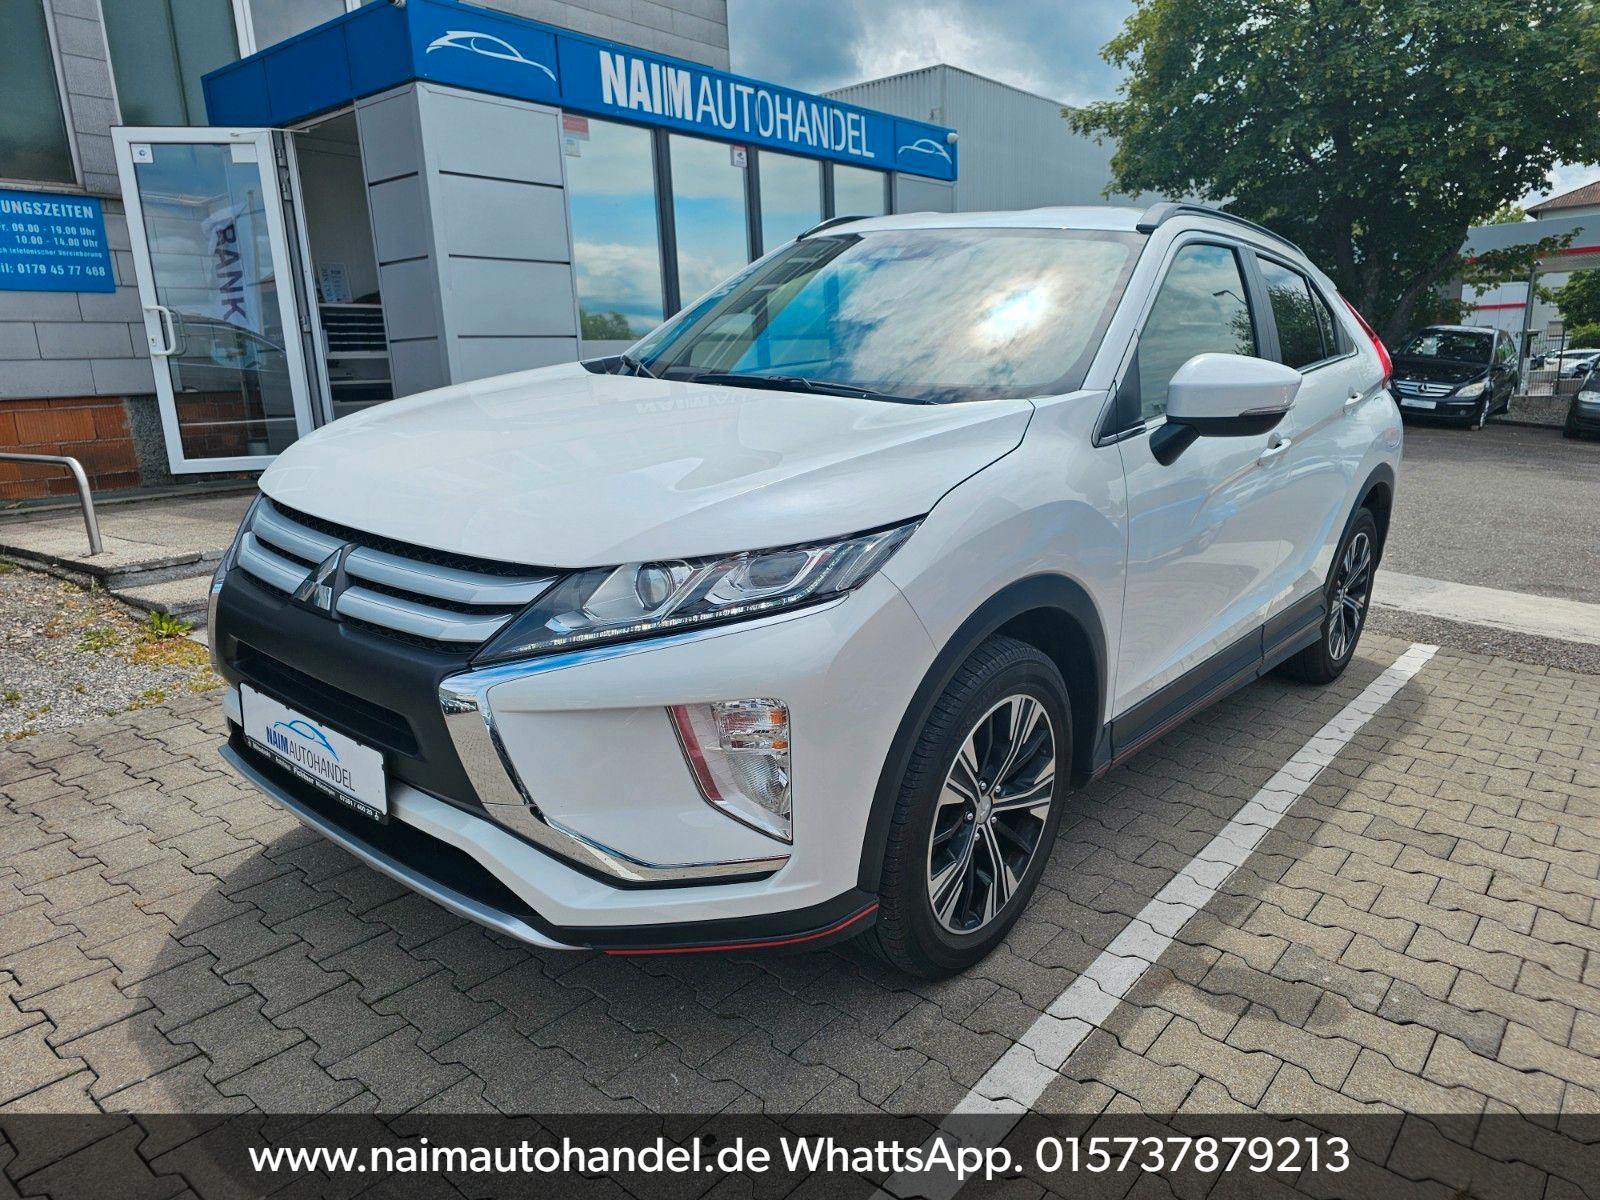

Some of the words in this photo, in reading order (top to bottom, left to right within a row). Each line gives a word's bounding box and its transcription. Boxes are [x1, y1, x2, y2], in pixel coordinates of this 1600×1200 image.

[0, 200, 94, 219] UNGSZEITEN
[80, 227, 96, 237] Uhr
[16, 235, 43, 245] 10.00
[83, 239, 99, 248] Uhr
[17, 263, 47, 274] 0179
[50, 265, 65, 275] 45
[67, 265, 80, 275] 77
